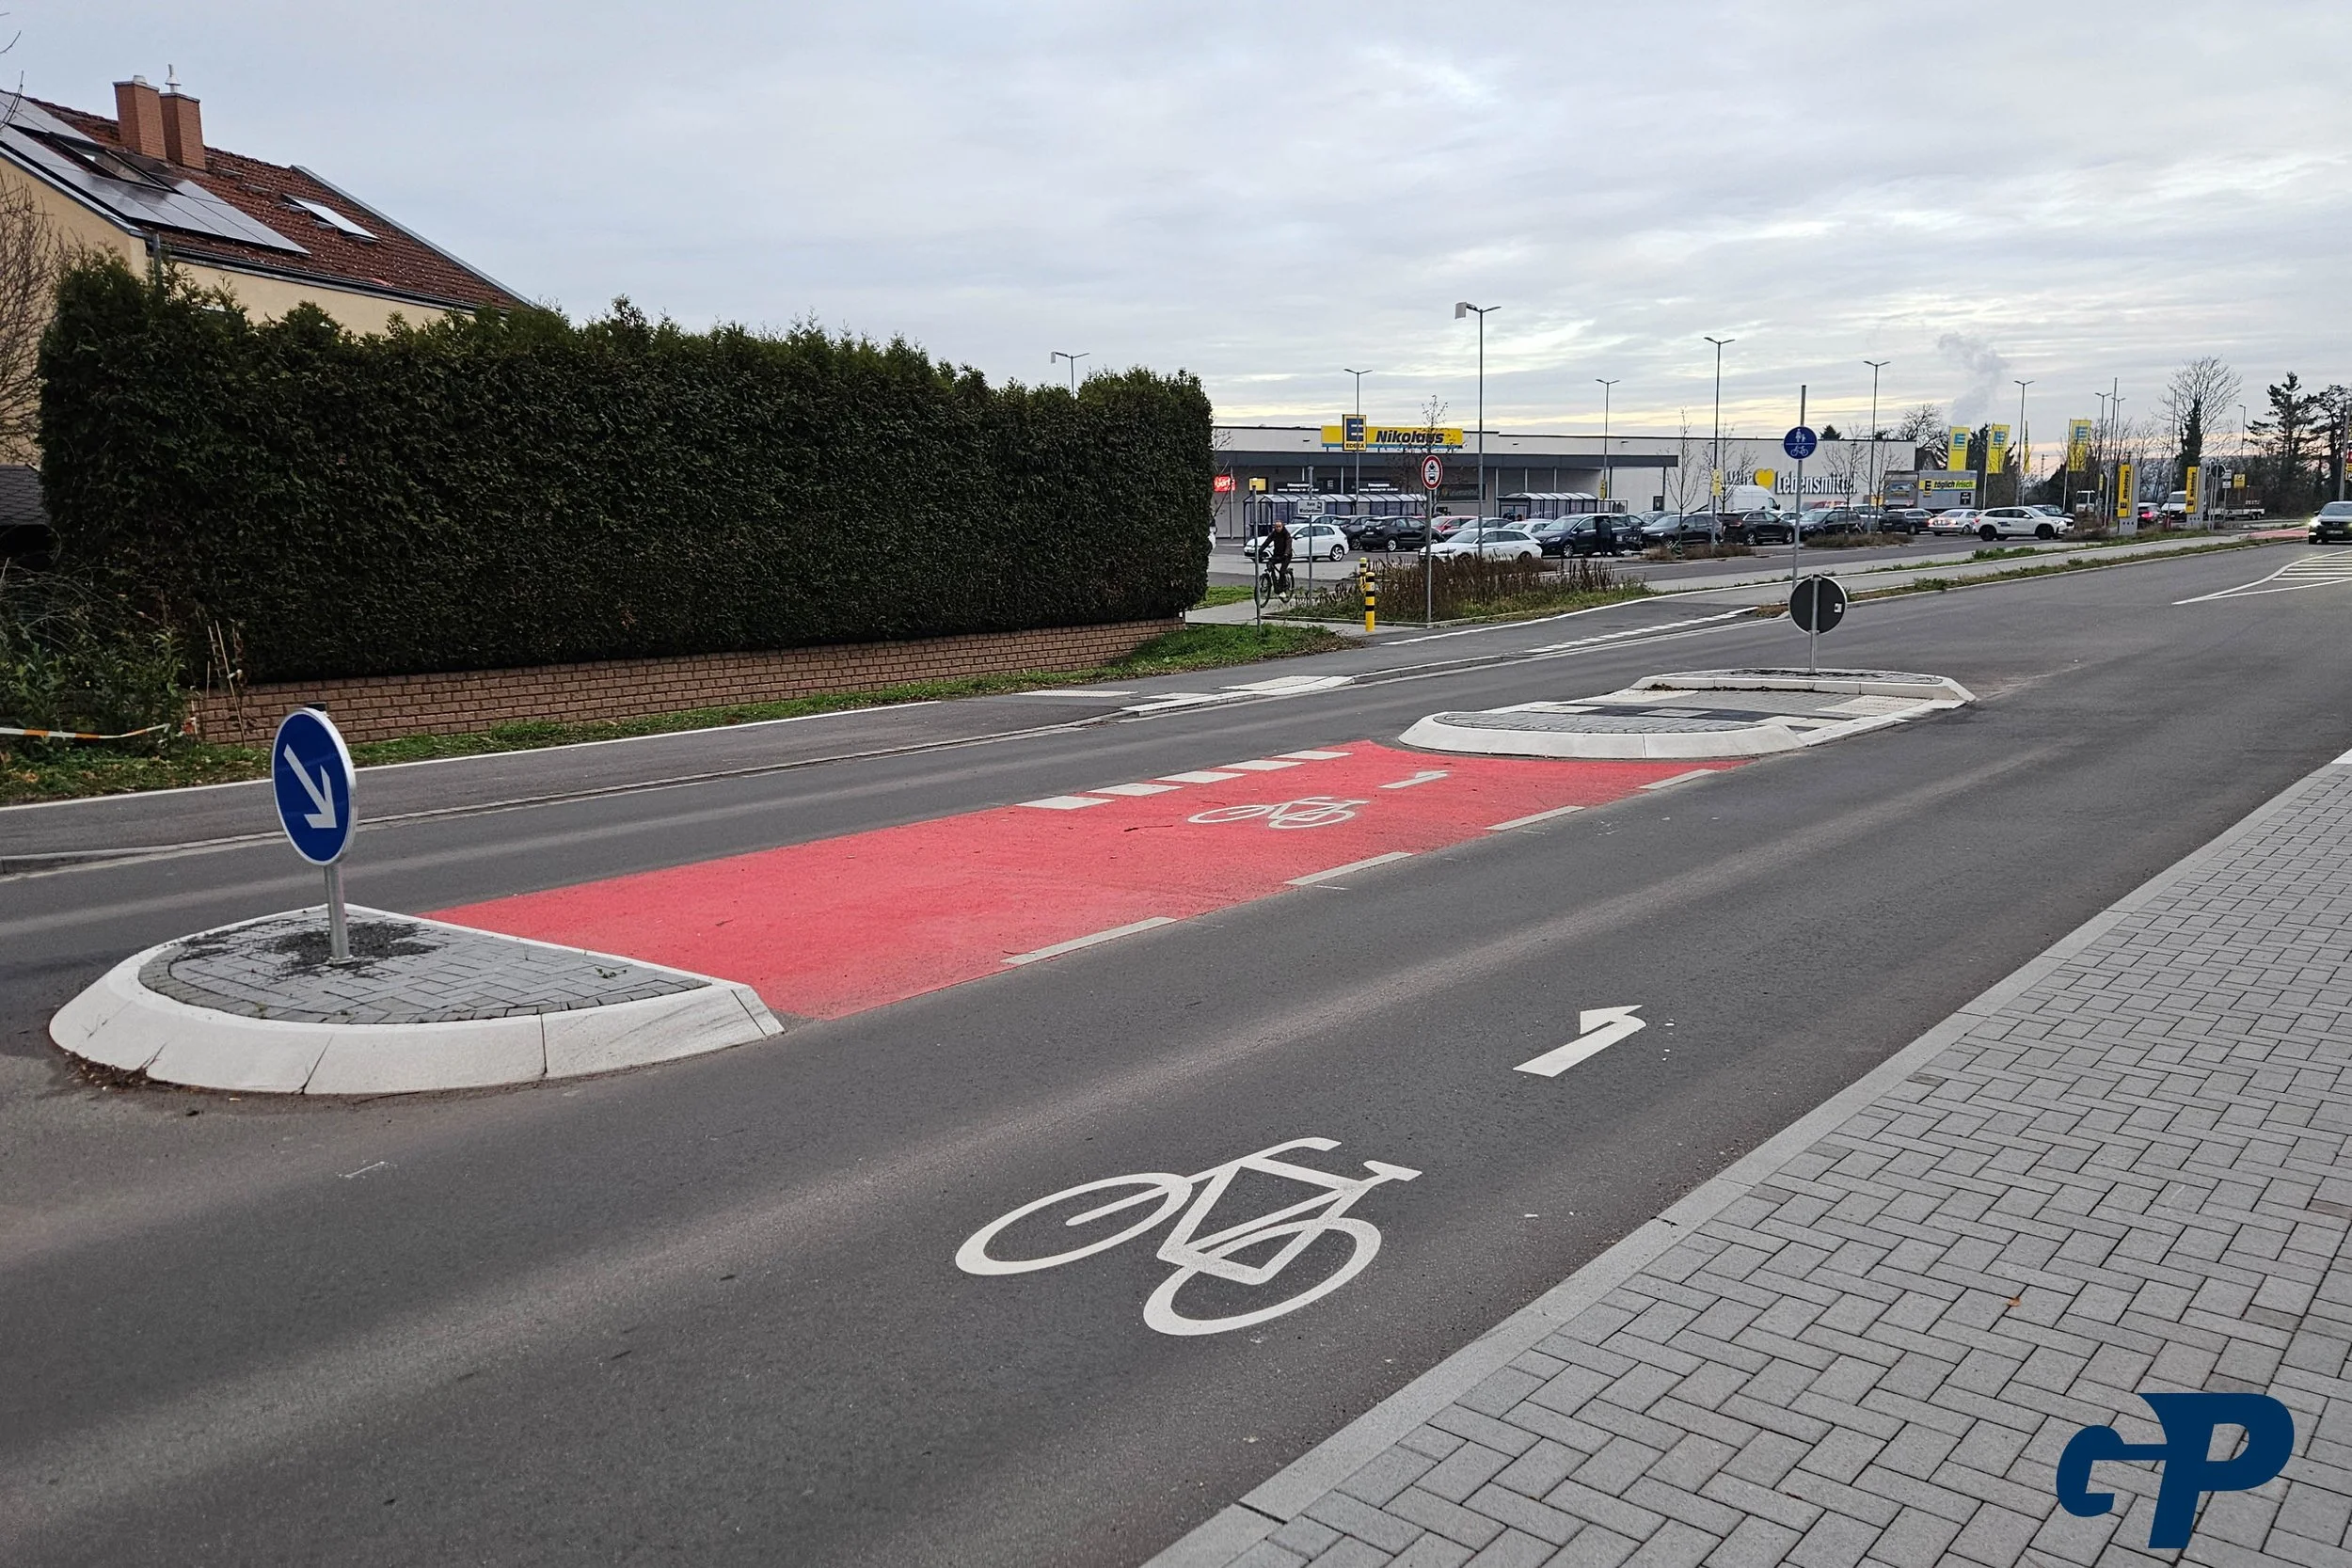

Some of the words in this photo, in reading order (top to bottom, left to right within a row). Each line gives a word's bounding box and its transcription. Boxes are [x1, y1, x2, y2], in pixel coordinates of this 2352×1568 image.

[1375, 430, 1445, 443] Nikolaus
[1933, 480, 1956, 488] täglich
[1955, 480, 1974, 488] frisch
